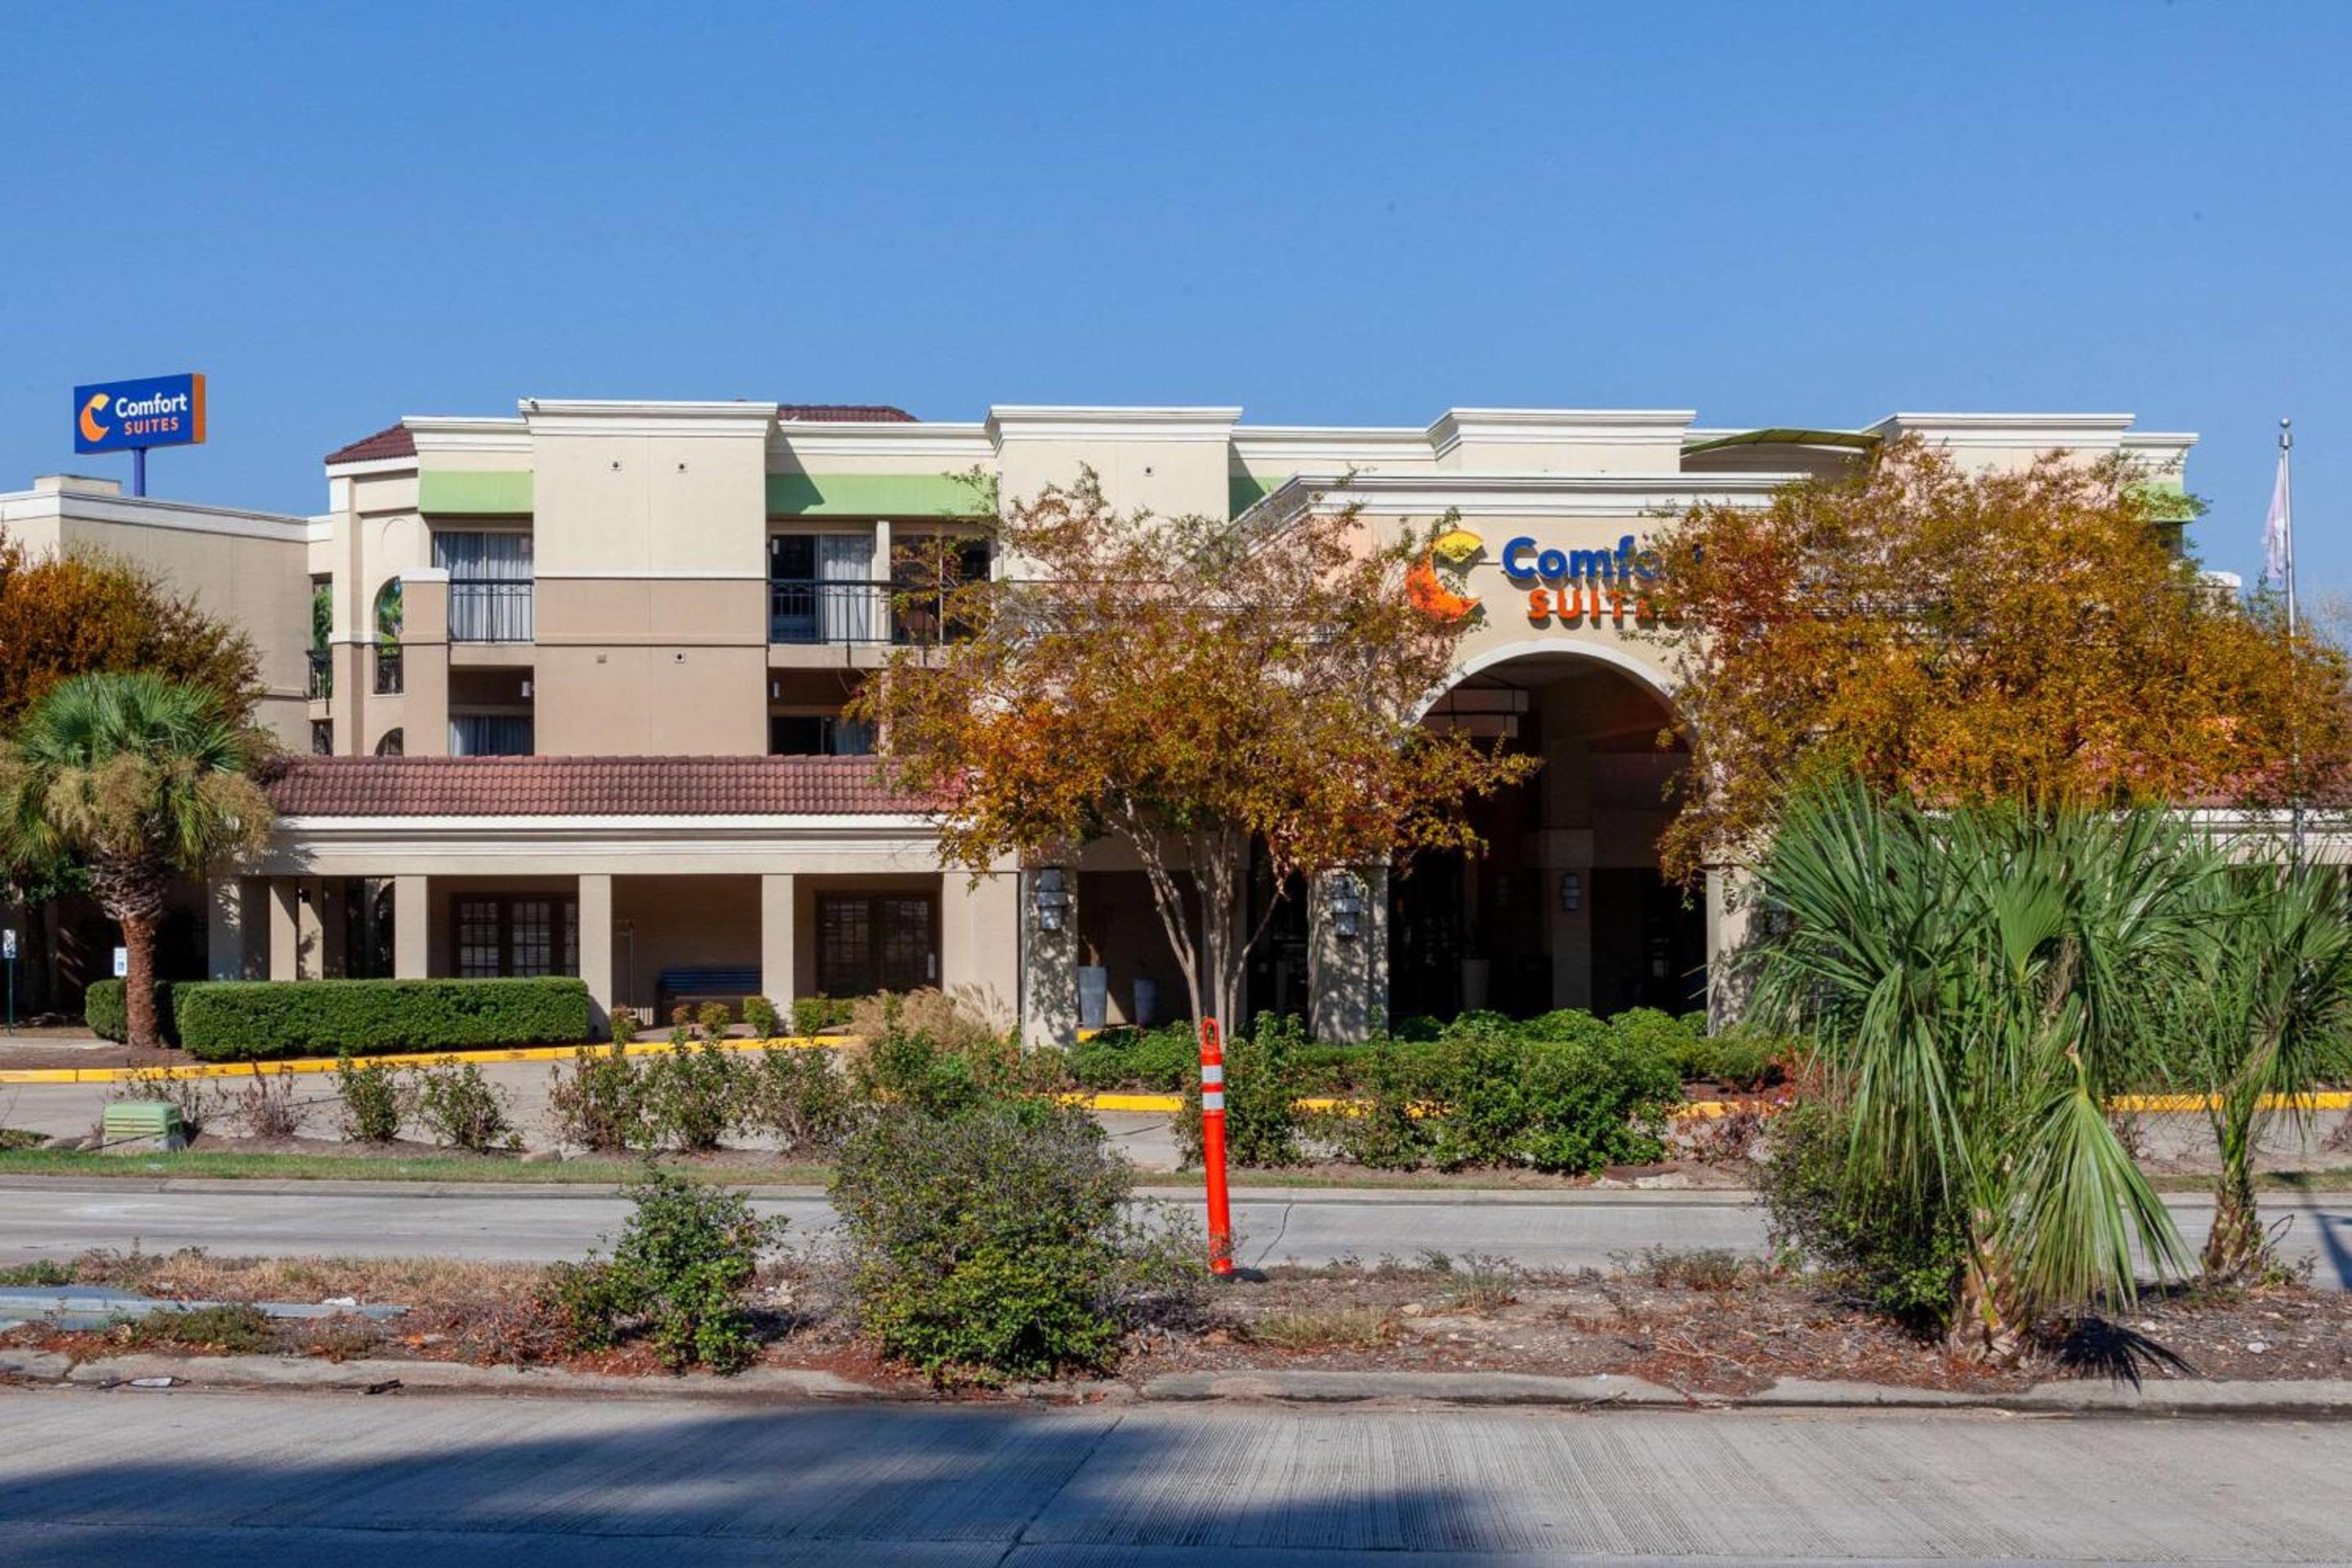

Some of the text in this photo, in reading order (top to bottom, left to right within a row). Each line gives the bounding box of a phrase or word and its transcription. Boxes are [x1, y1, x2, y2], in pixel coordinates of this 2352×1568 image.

[115, 392, 188, 417] Comfort
[124, 416, 179, 435] SUITES
[1503, 535, 1704, 579] Comfo
